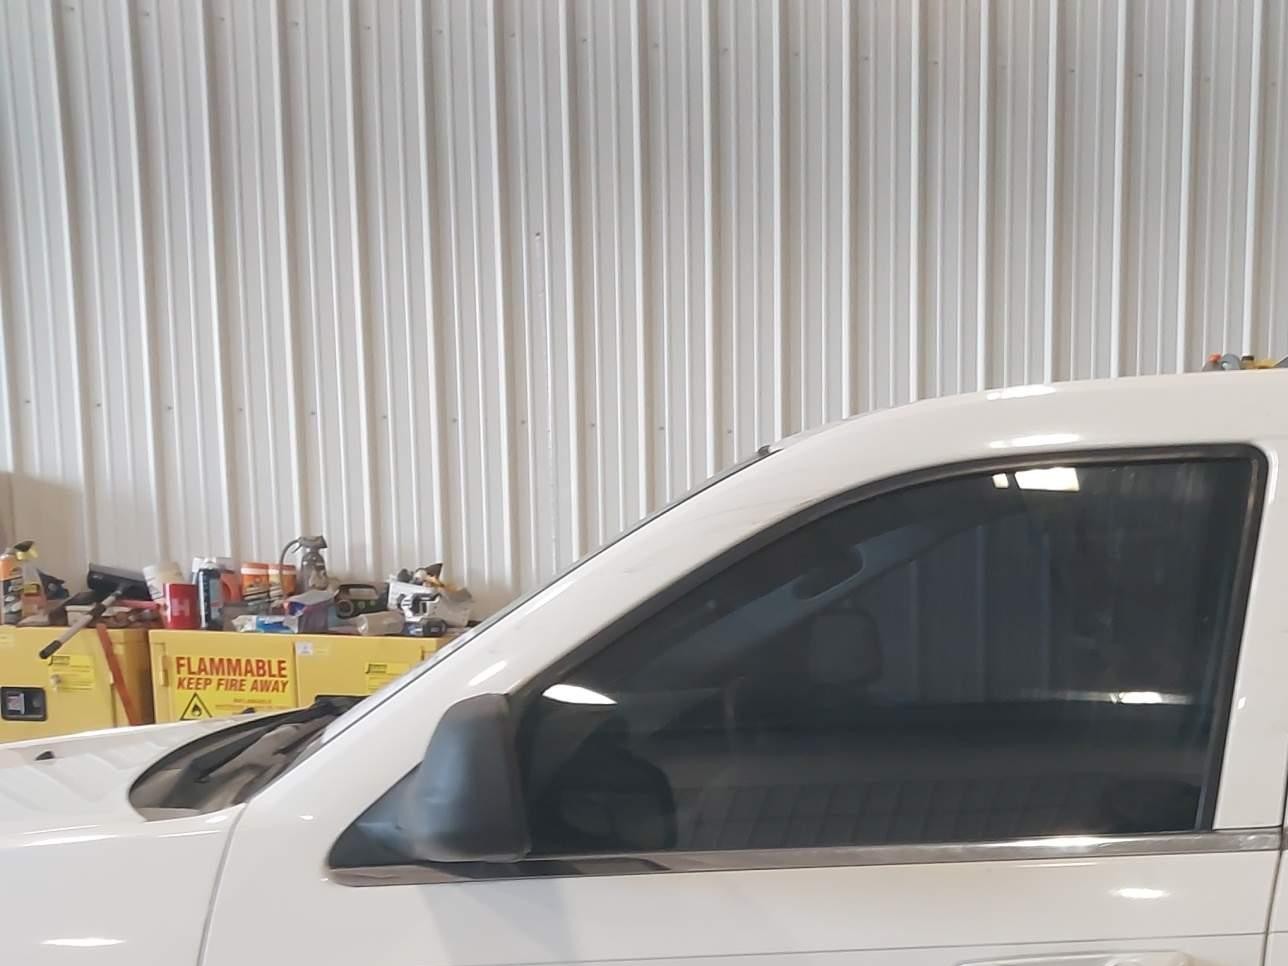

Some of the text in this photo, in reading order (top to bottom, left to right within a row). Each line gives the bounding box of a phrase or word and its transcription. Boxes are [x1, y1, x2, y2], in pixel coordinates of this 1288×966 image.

[175, 656, 288, 678] FLAMMABLE
[176, 677, 289, 693] KEEP FIRE AWAY
